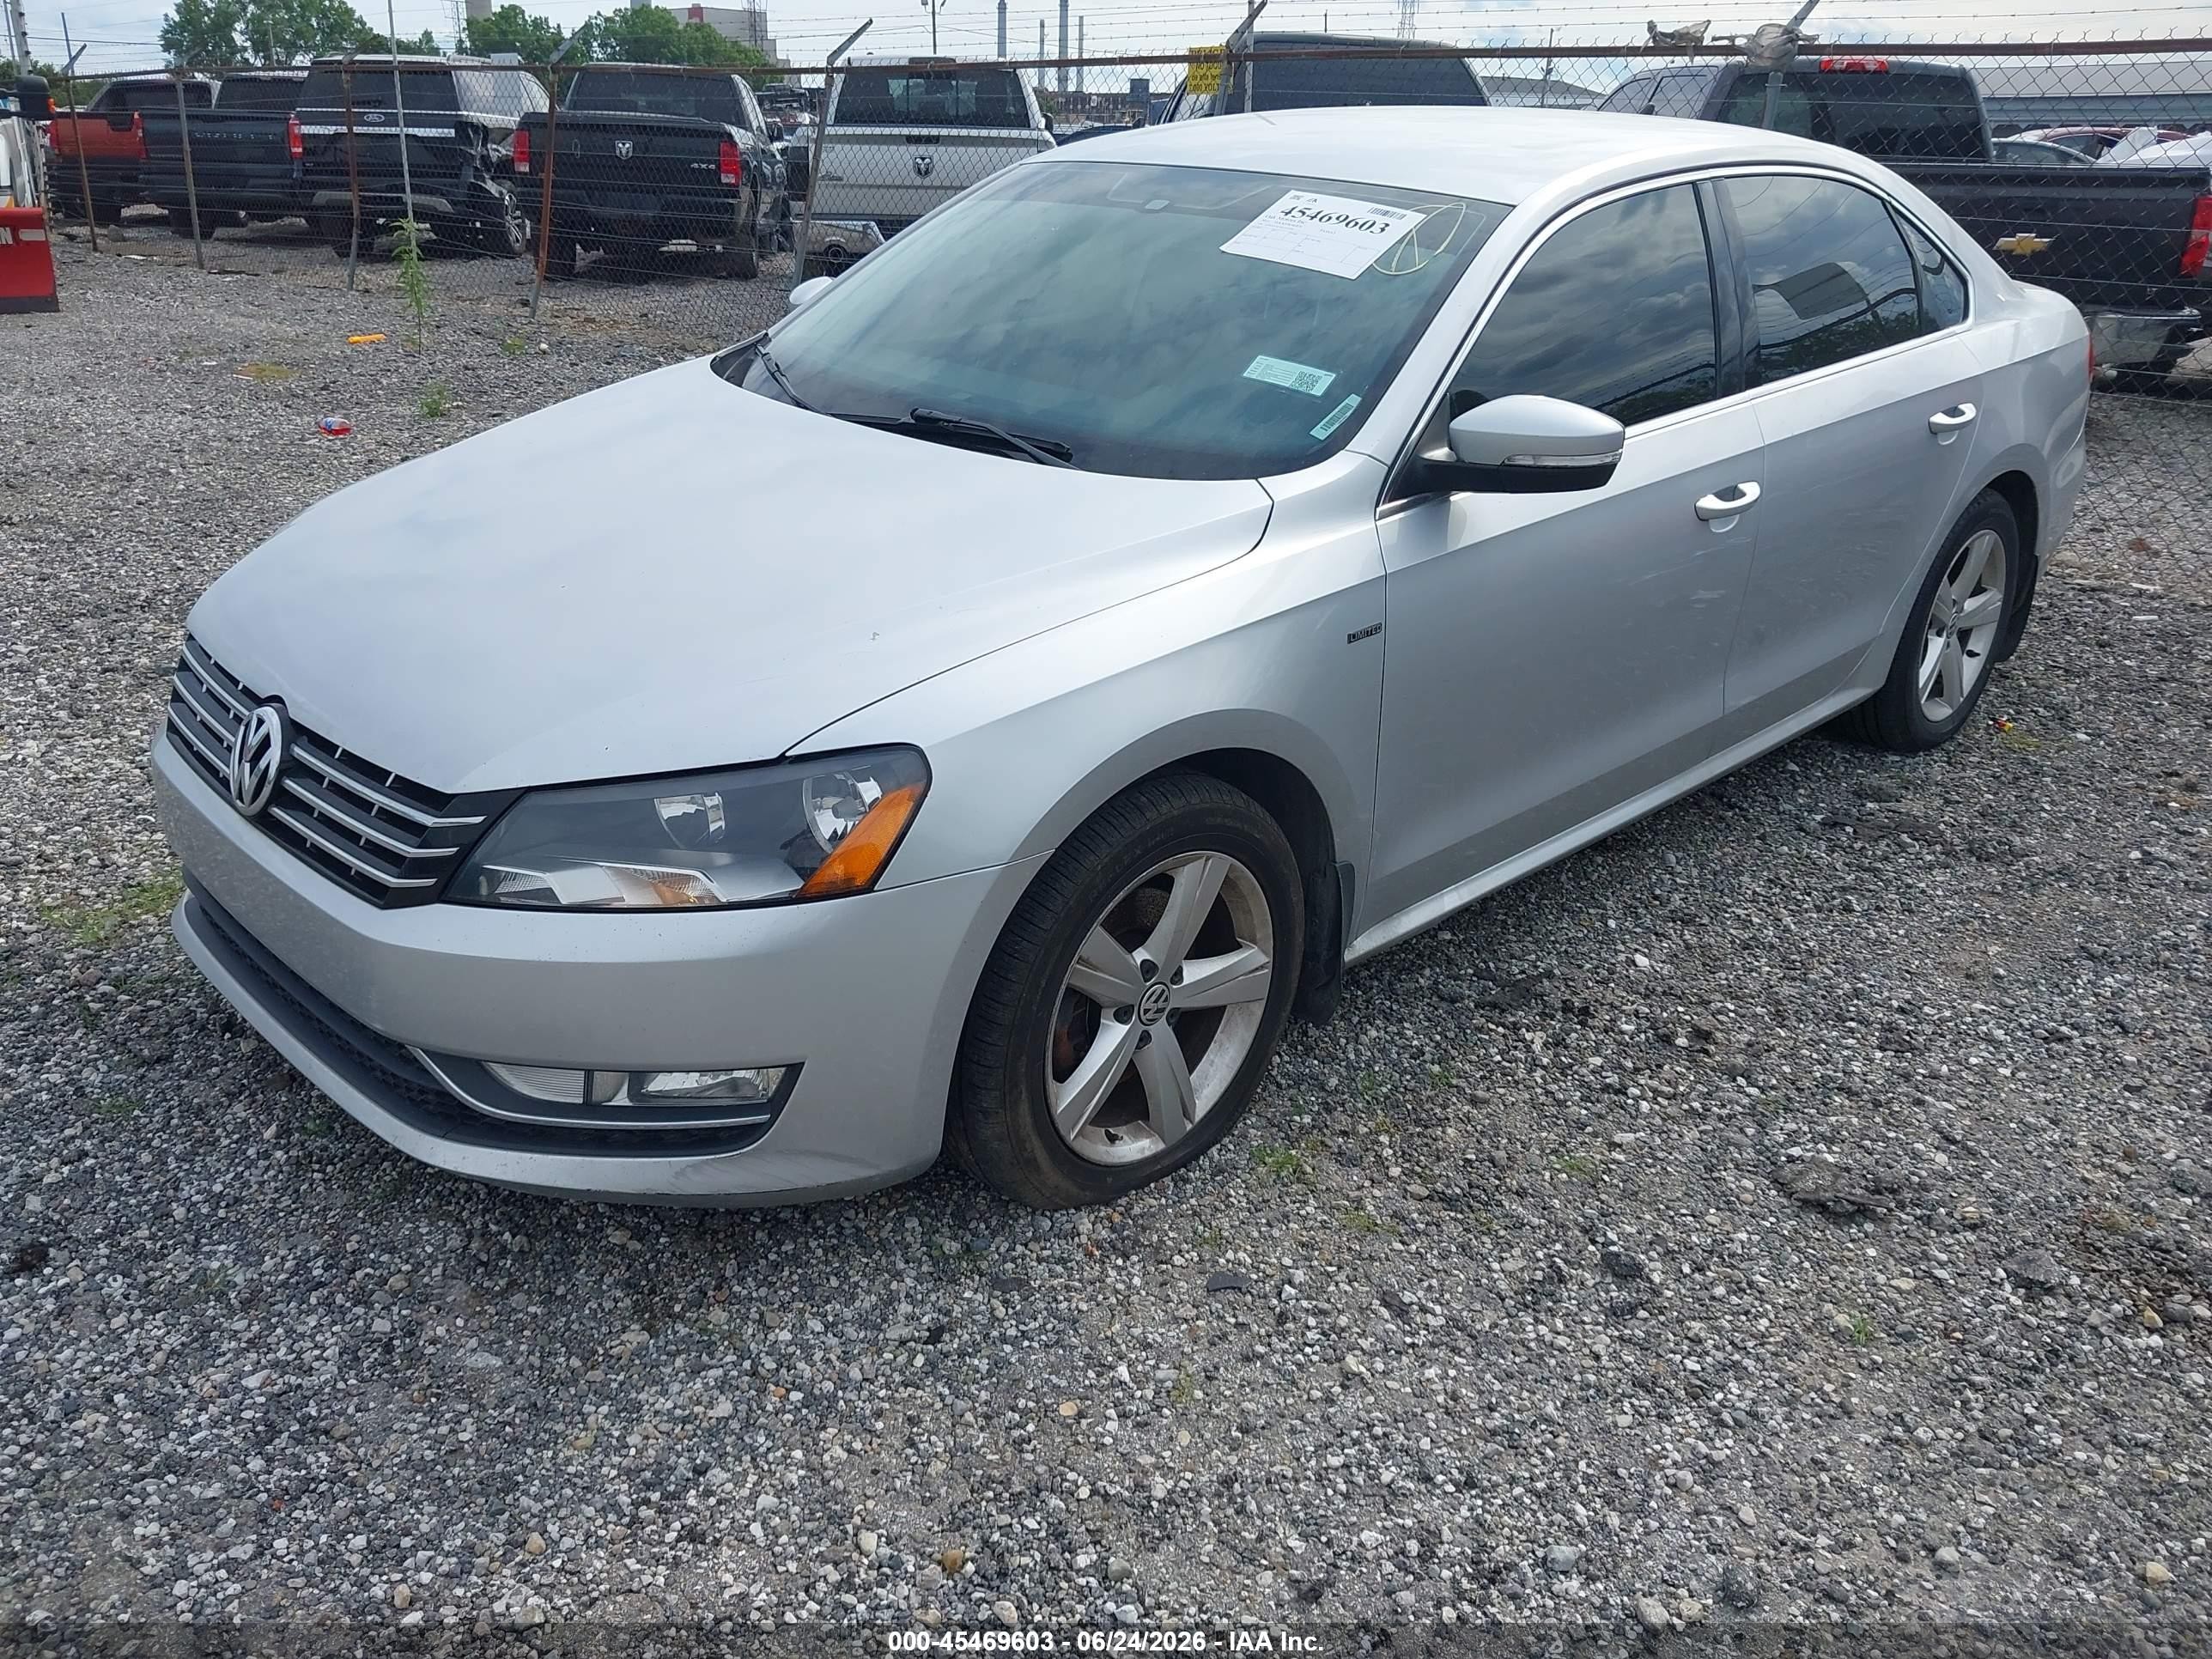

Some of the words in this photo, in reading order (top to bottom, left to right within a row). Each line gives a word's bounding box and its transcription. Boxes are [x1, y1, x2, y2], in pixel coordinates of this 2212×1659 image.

[1280, 205, 1390, 234] 45469603
[1348, 623, 1382, 643] LIMITED
[229, 706, 282, 816] VW
